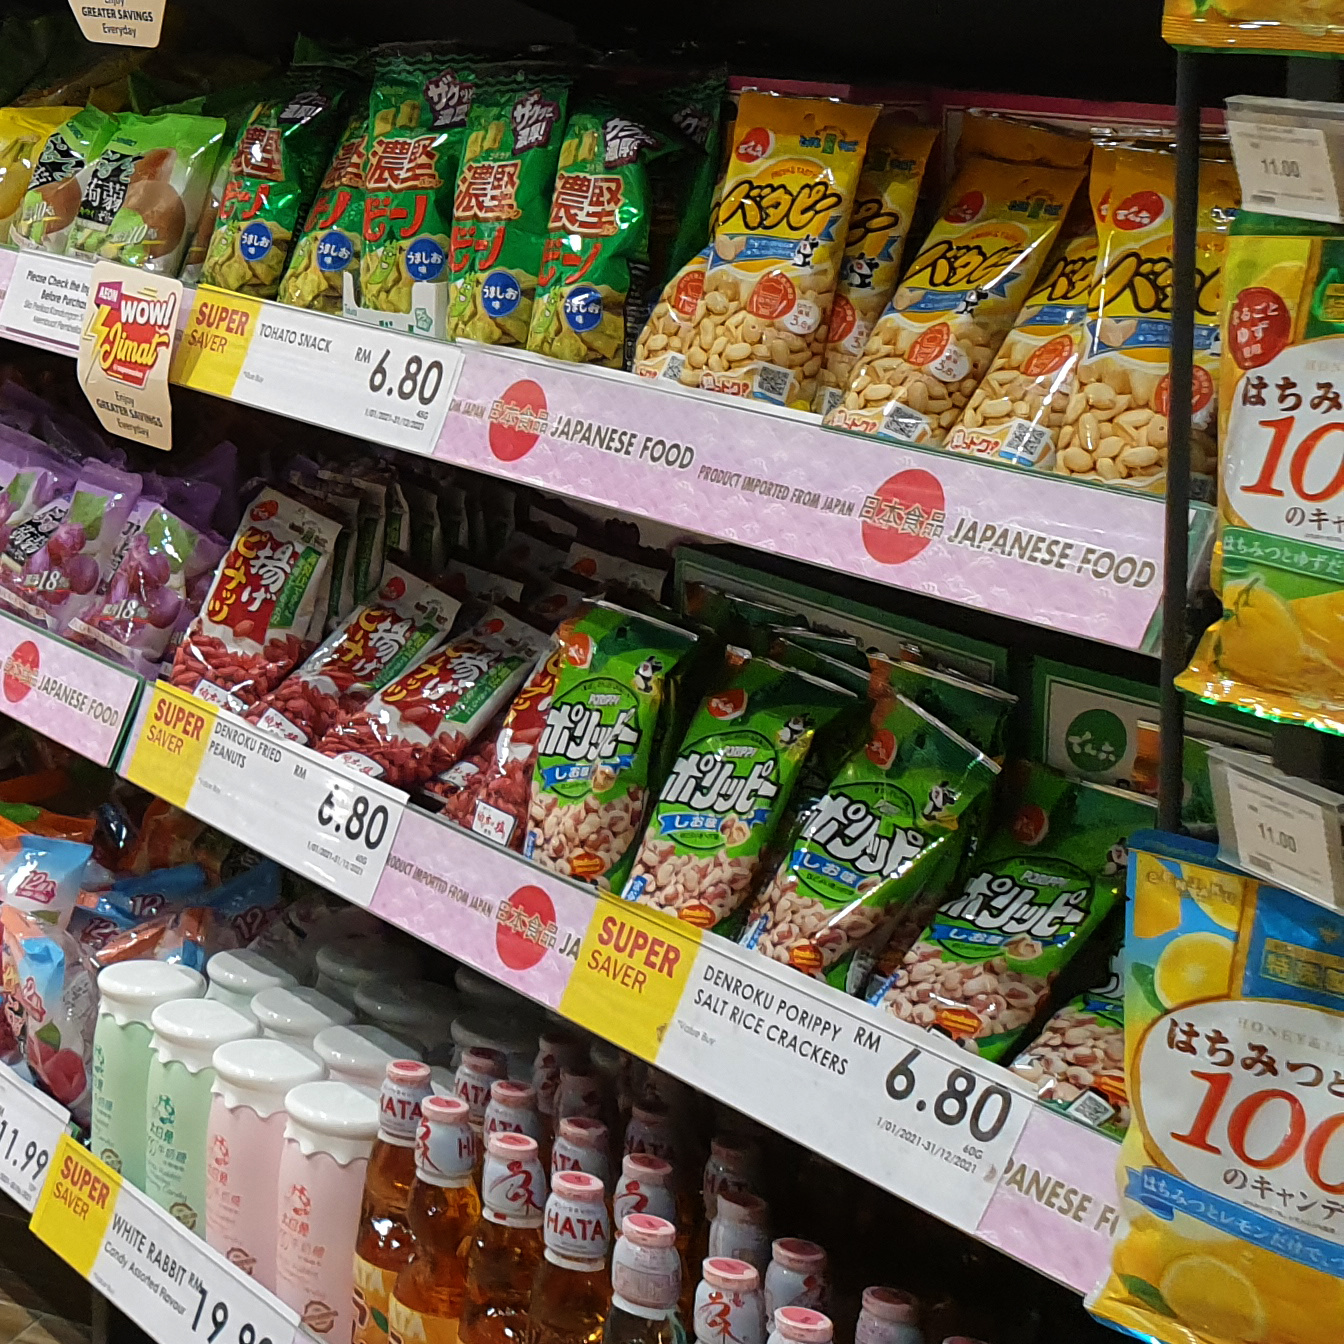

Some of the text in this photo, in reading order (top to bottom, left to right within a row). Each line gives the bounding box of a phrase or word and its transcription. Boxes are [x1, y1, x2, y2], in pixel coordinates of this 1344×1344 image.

[81, 6, 155, 23] GREATER SAVINGS
[101, 22, 138, 39] Everyday
[1260, 156, 1301, 180] 11.00
[721, 180, 842, 232] バタピー
[482, 285, 519, 302] うましお
[194, 300, 251, 337] SUPER
[187, 330, 228, 355] SAVER
[258, 323, 445, 405] TOHATO SNACK RM 6.80
[551, 414, 695, 469] JAPANESE FOOD
[697, 465, 855, 517] PRODUCT IMPORTED FROM JAPAN
[858, 494, 947, 540] 日本食品
[947, 517, 1156, 588] JAPANESE FOOD
[38, 570, 61, 591] 18
[37, 674, 120, 728] JAPANESE FOOD
[153, 696, 206, 743] SUPER
[146, 724, 185, 757] SAVER
[208, 739, 248, 770] PEANUTS
[214, 723, 283, 764] DENROKU FRIED
[293, 764, 308, 781] RM
[662, 748, 780, 816] ポリッピー
[1256, 822, 1298, 855] 11.00
[941, 870, 1088, 939] ポリッピー
[587, 948, 648, 995] SAVER
[597, 915, 681, 981] SUPER
[693, 988, 850, 1078] SALT RICE CRACKERS
[703, 965, 882, 1054] DENROKU PORIPPY RM
[884, 1046, 1012, 1144] 6.80
[875, 1115, 979, 1176] 1/01/2021-31/12/2021
[962, 1142, 983, 1160] 60G
[52, 1181, 91, 1221] SAVER
[60, 1155, 111, 1211] SUPER
[547, 1210, 606, 1242] HATA
[111, 1213, 188, 1287] WHITE RABBIT
[103, 1240, 129, 1271] Candy
[128, 1262, 161, 1296] Assorted
[160, 1284, 188, 1316] Flavour
